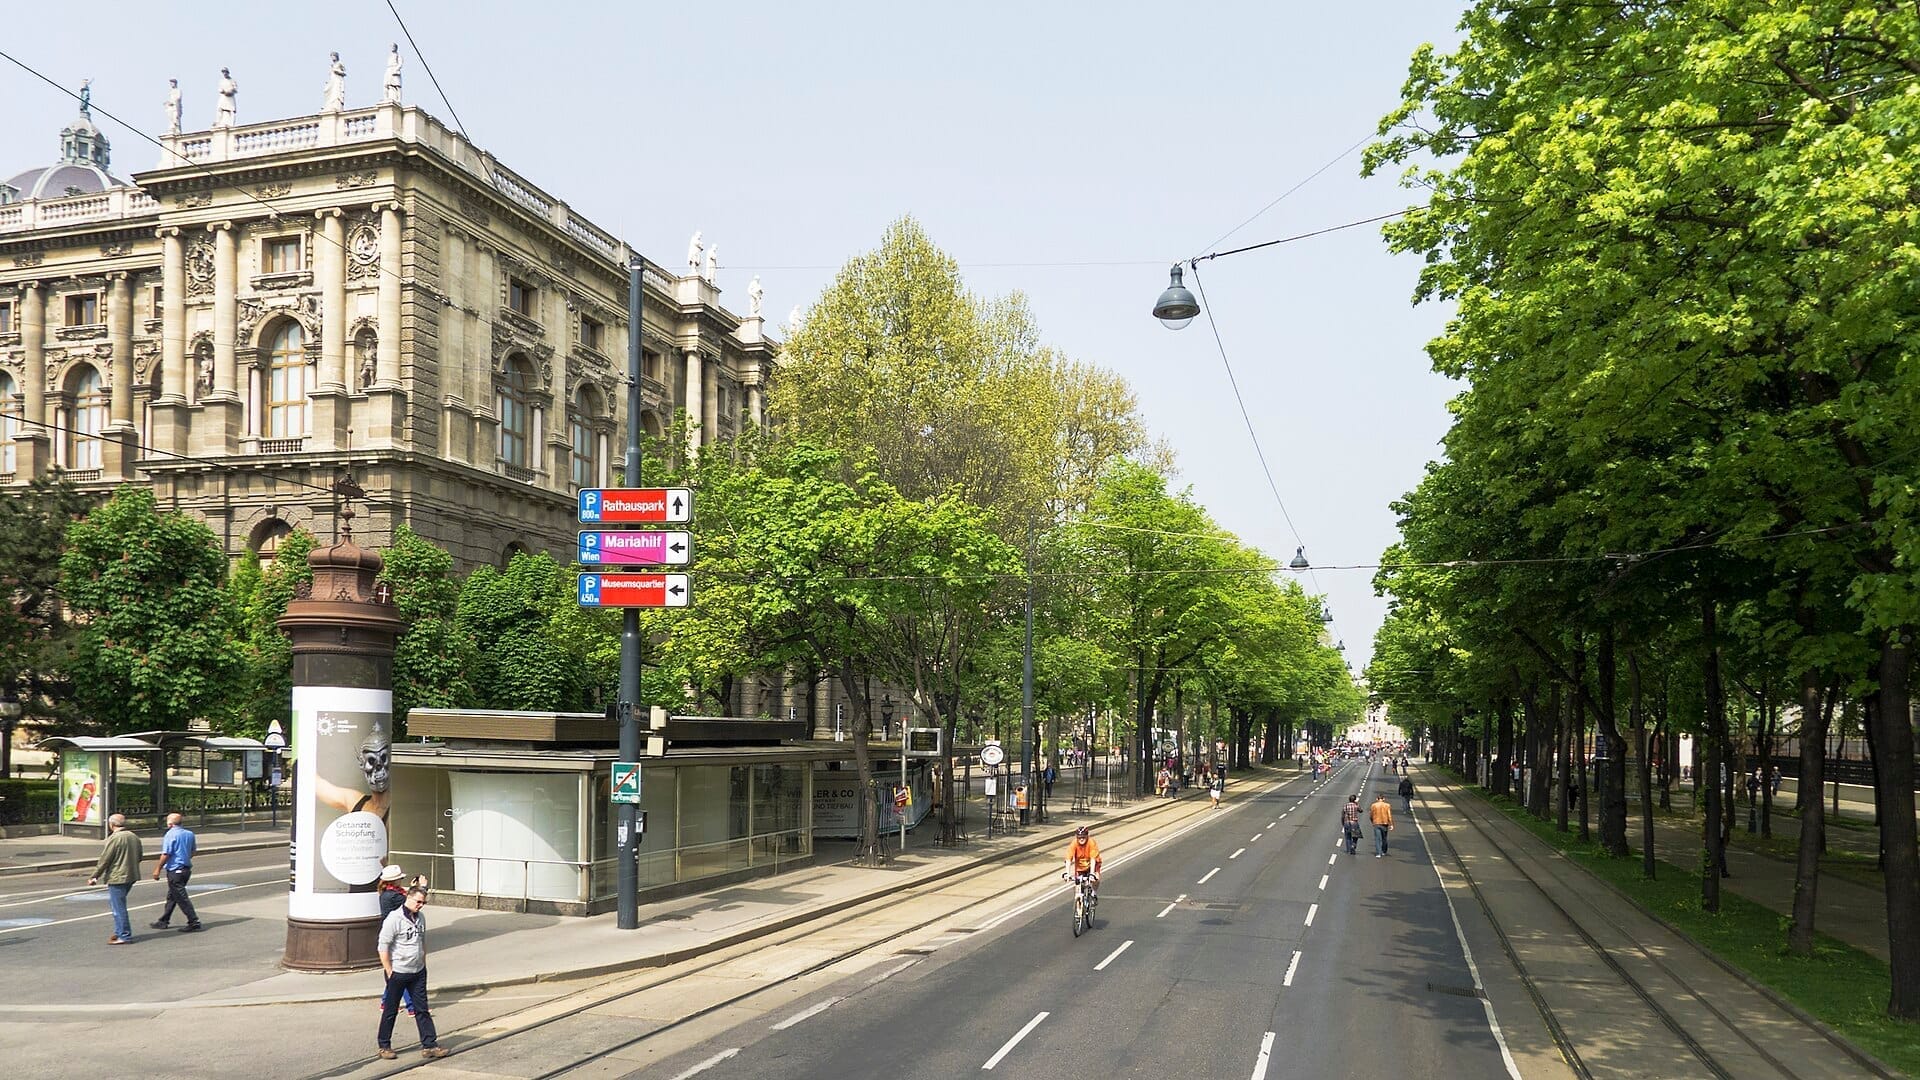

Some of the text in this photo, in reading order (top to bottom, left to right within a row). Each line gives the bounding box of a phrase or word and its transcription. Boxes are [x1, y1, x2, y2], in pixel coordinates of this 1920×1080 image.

[603, 500, 664, 513] Rathauspark
[605, 535, 662, 547] Mariahilf
[581, 551, 600, 561] Wien
[601, 579, 664, 589] Museumsquartier
[831, 789, 838, 798] &
[840, 789, 854, 798] CO
[336, 821, 372, 829] Getanzte
